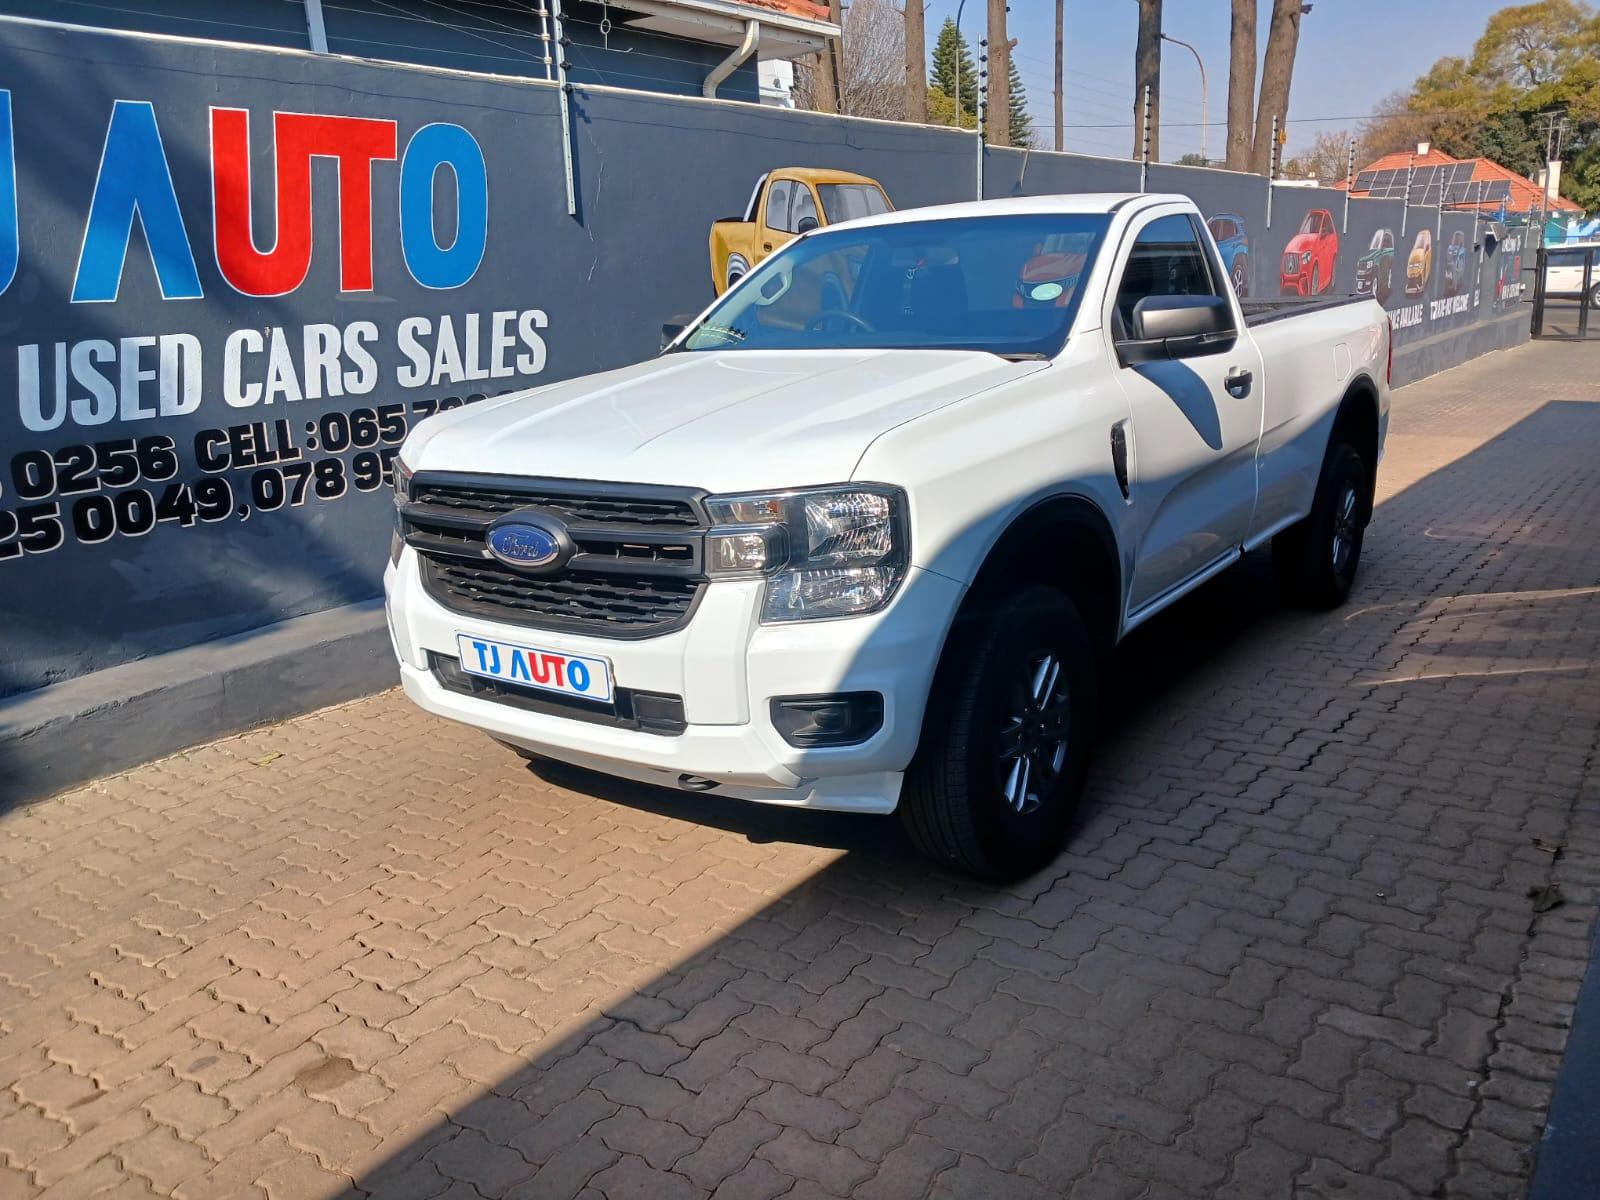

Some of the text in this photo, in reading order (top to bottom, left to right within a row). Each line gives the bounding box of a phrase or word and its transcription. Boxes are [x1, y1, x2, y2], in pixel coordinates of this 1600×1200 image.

[70, 99, 489, 303] AUTO
[17, 309, 549, 432] USED CARS SALES
[10, 435, 179, 500] 0256
[501, 531, 539, 558] Ford
[472, 641, 591, 692] TJ AUTO
